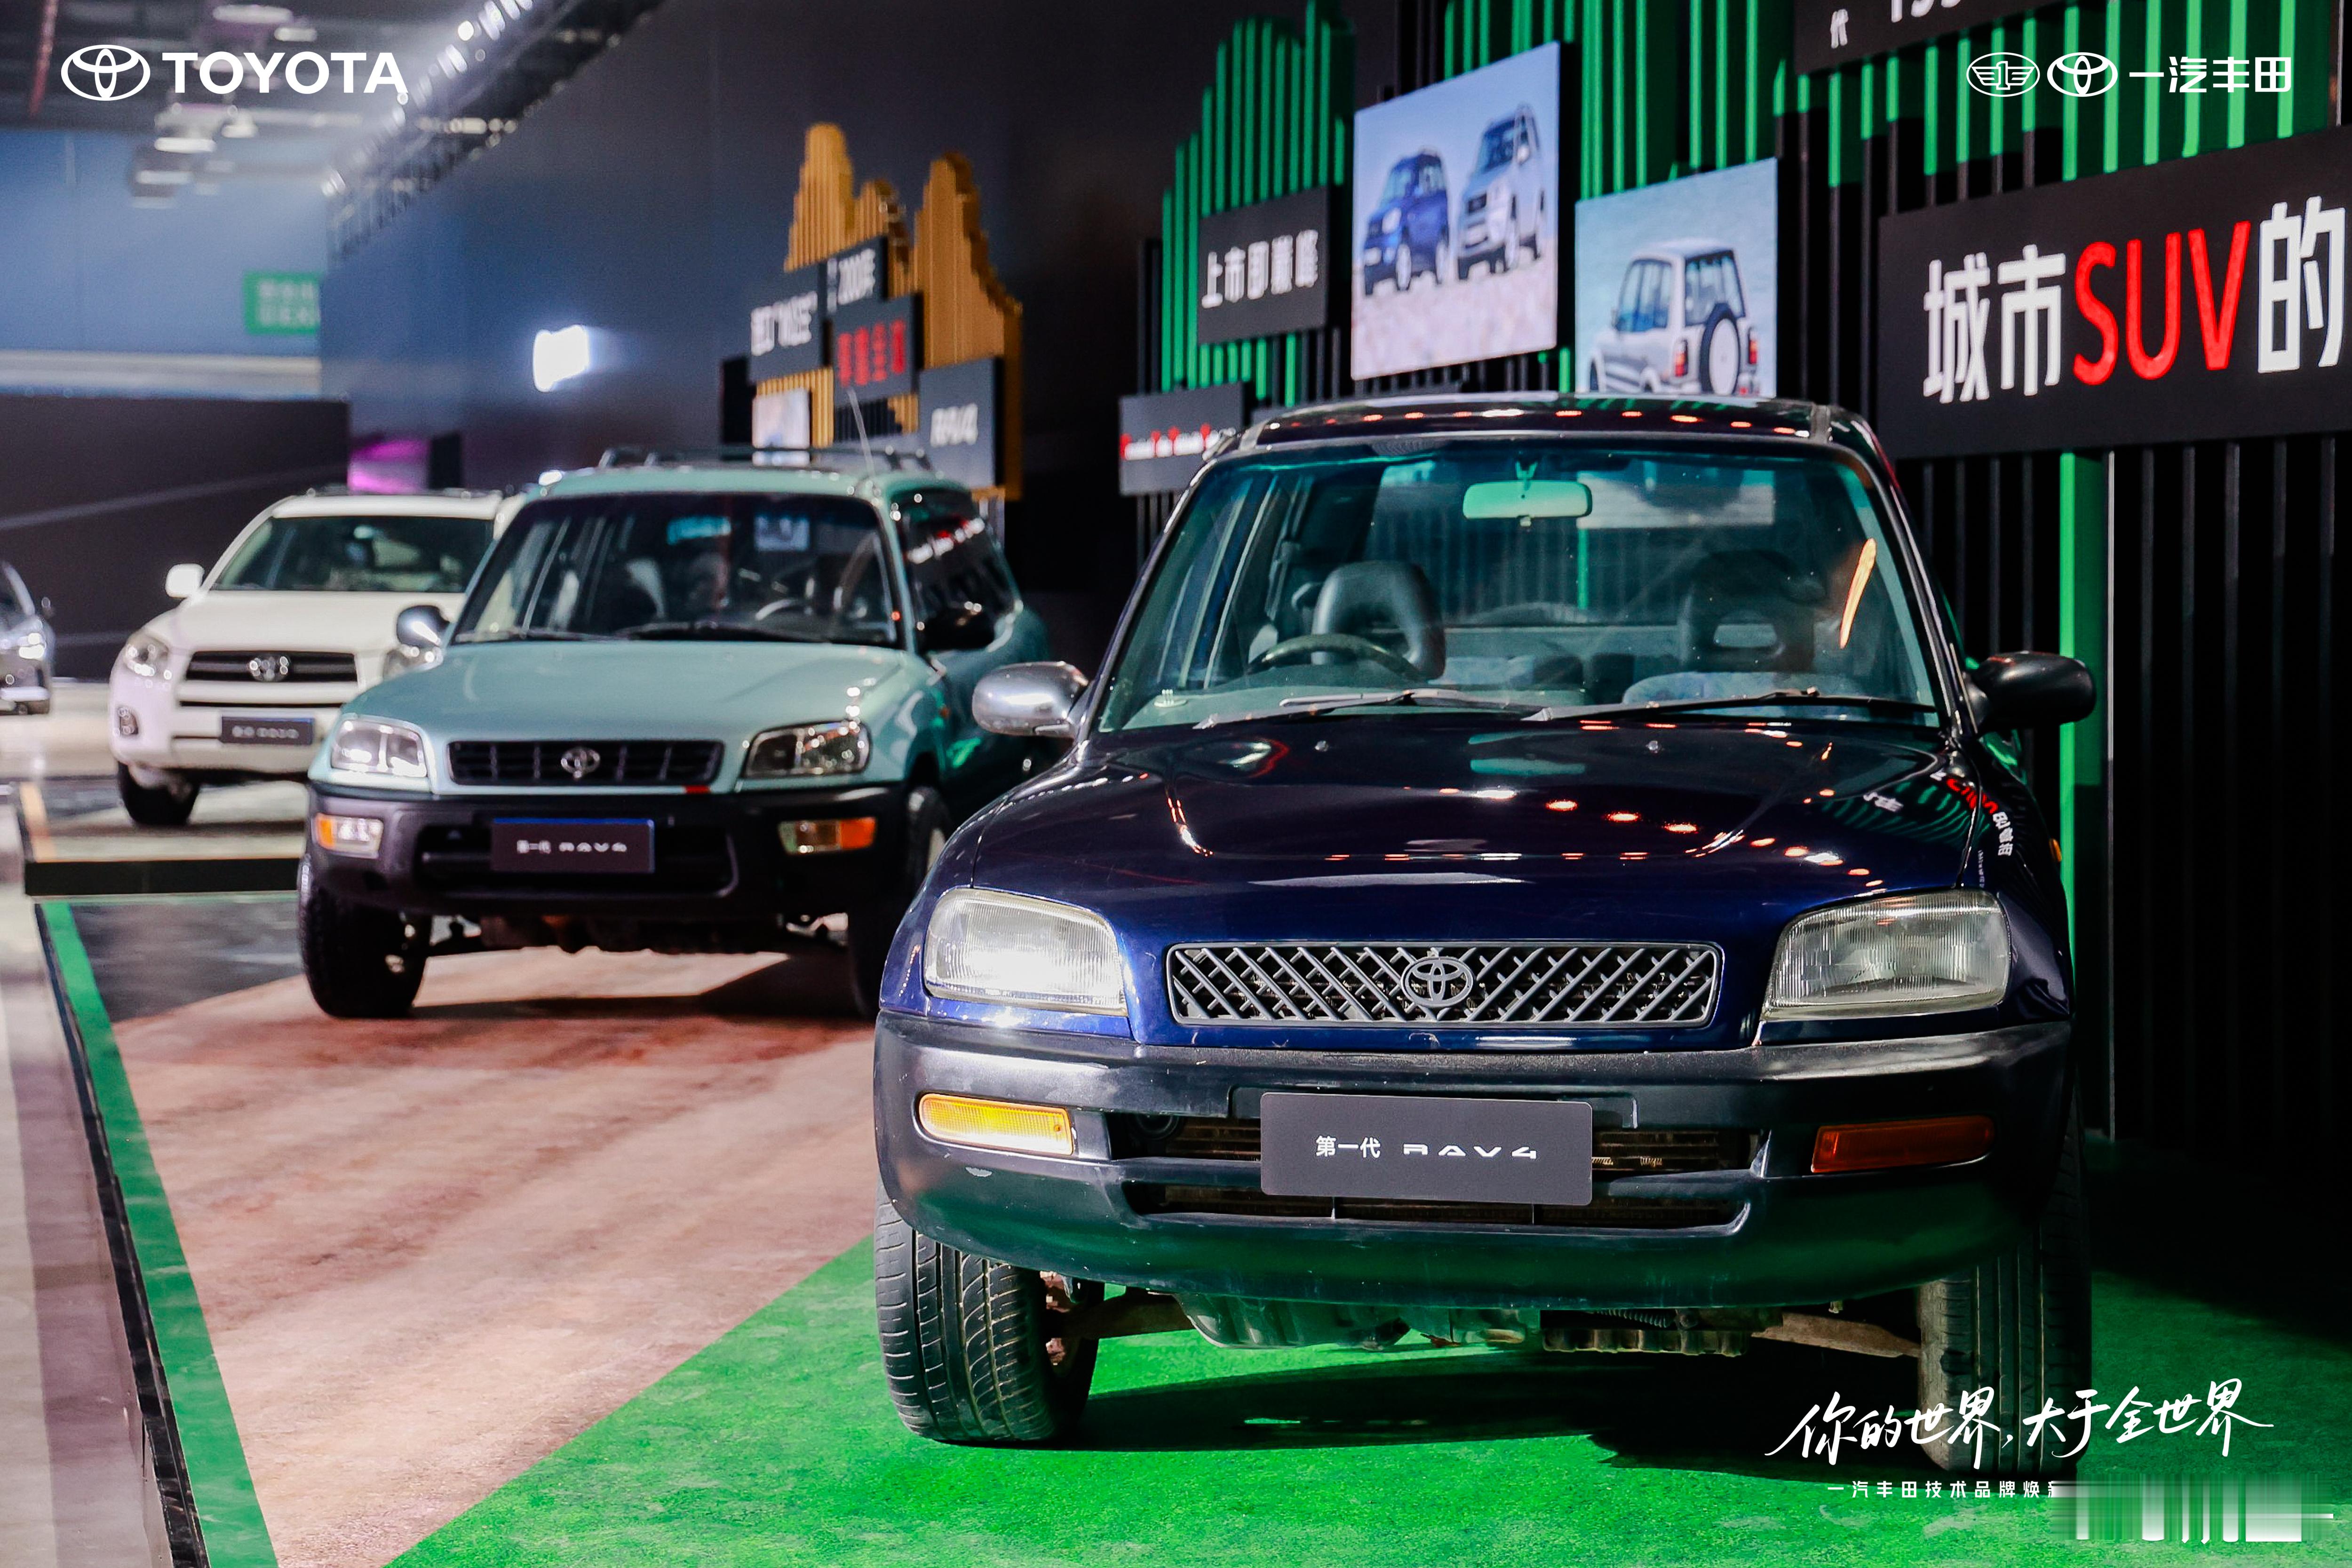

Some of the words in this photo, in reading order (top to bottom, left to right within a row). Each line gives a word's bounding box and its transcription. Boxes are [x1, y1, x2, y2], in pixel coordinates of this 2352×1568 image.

[1923, 195, 2346, 404] 城市SUV的
[1315, 1134, 1381, 1159] 第一代
[1403, 1143, 1537, 1160] RAV4
